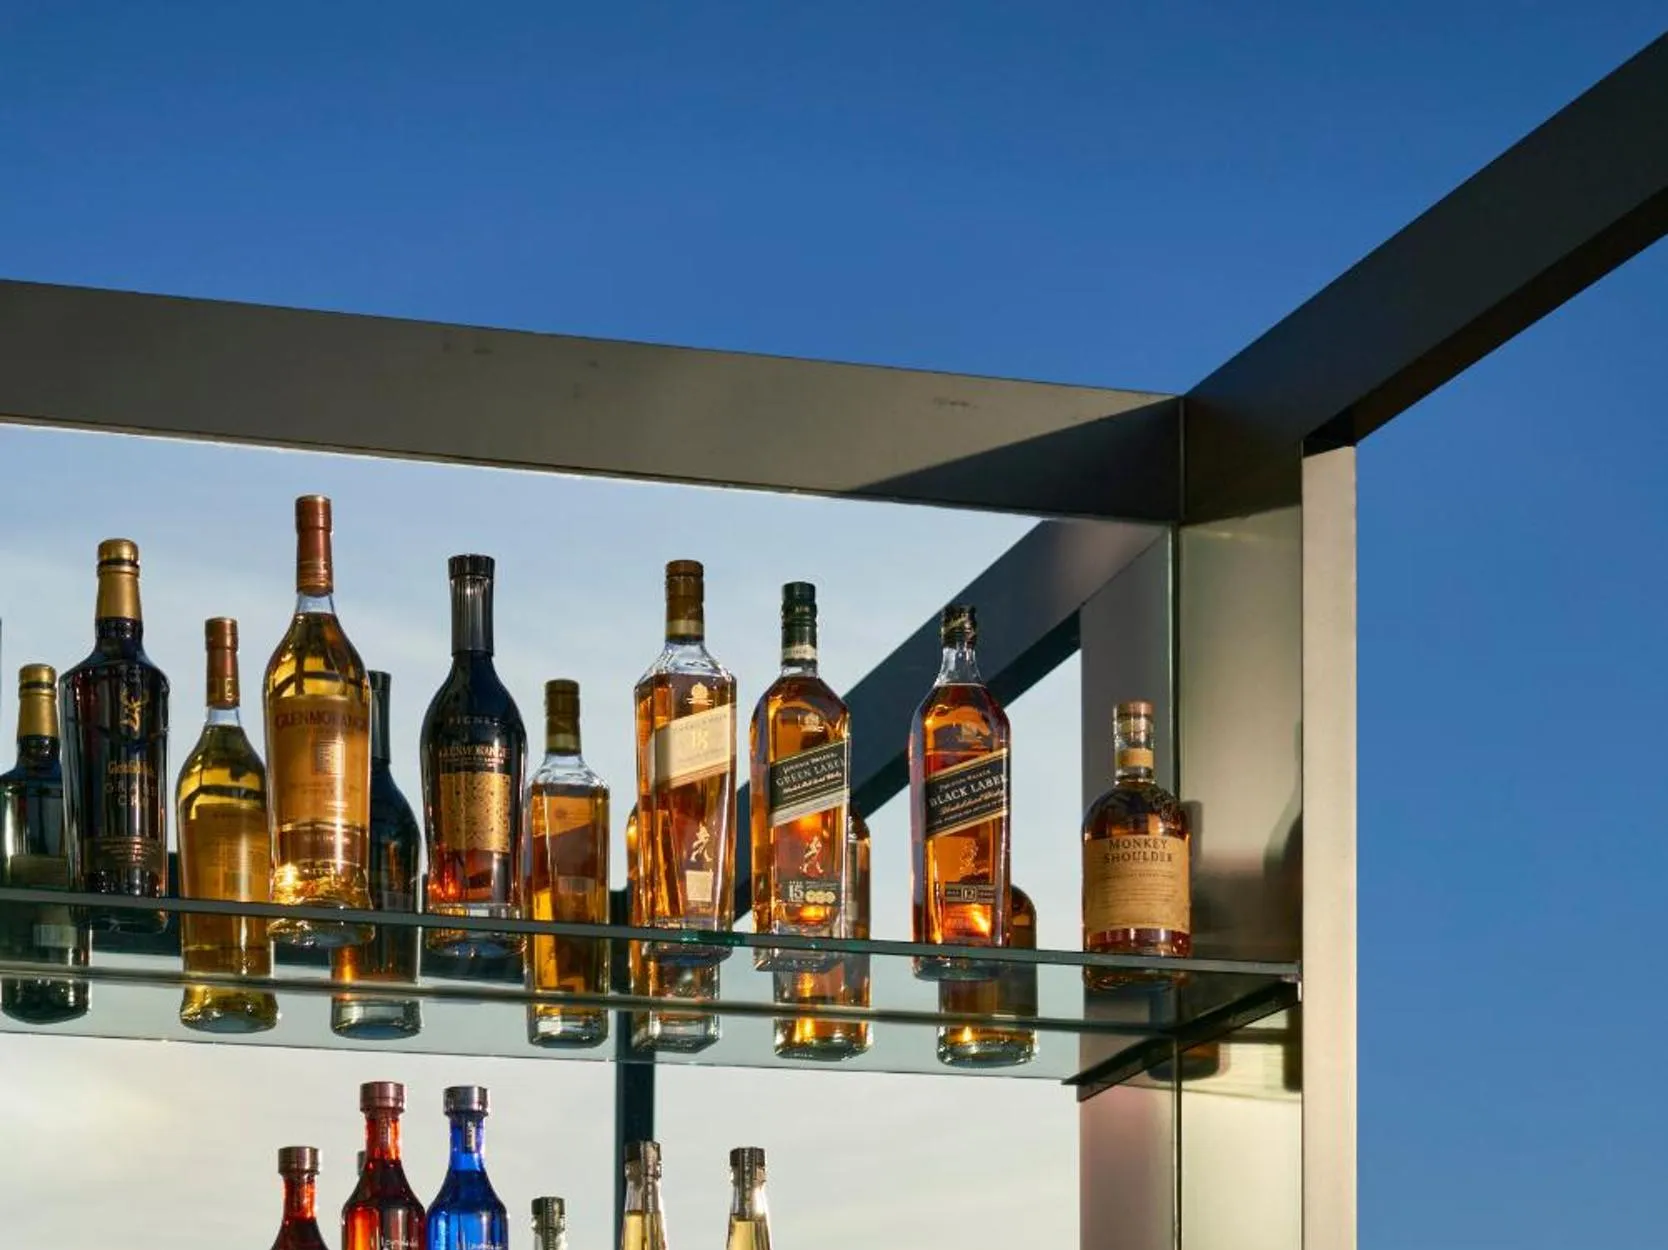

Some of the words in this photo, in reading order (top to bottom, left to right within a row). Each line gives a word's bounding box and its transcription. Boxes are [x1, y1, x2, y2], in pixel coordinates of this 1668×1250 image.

[775, 770, 813, 787] GREEN
[928, 785, 968, 808] BLACK
[1108, 837, 1168, 850] MONKEY
[1103, 850, 1173, 864] SHOULDER
